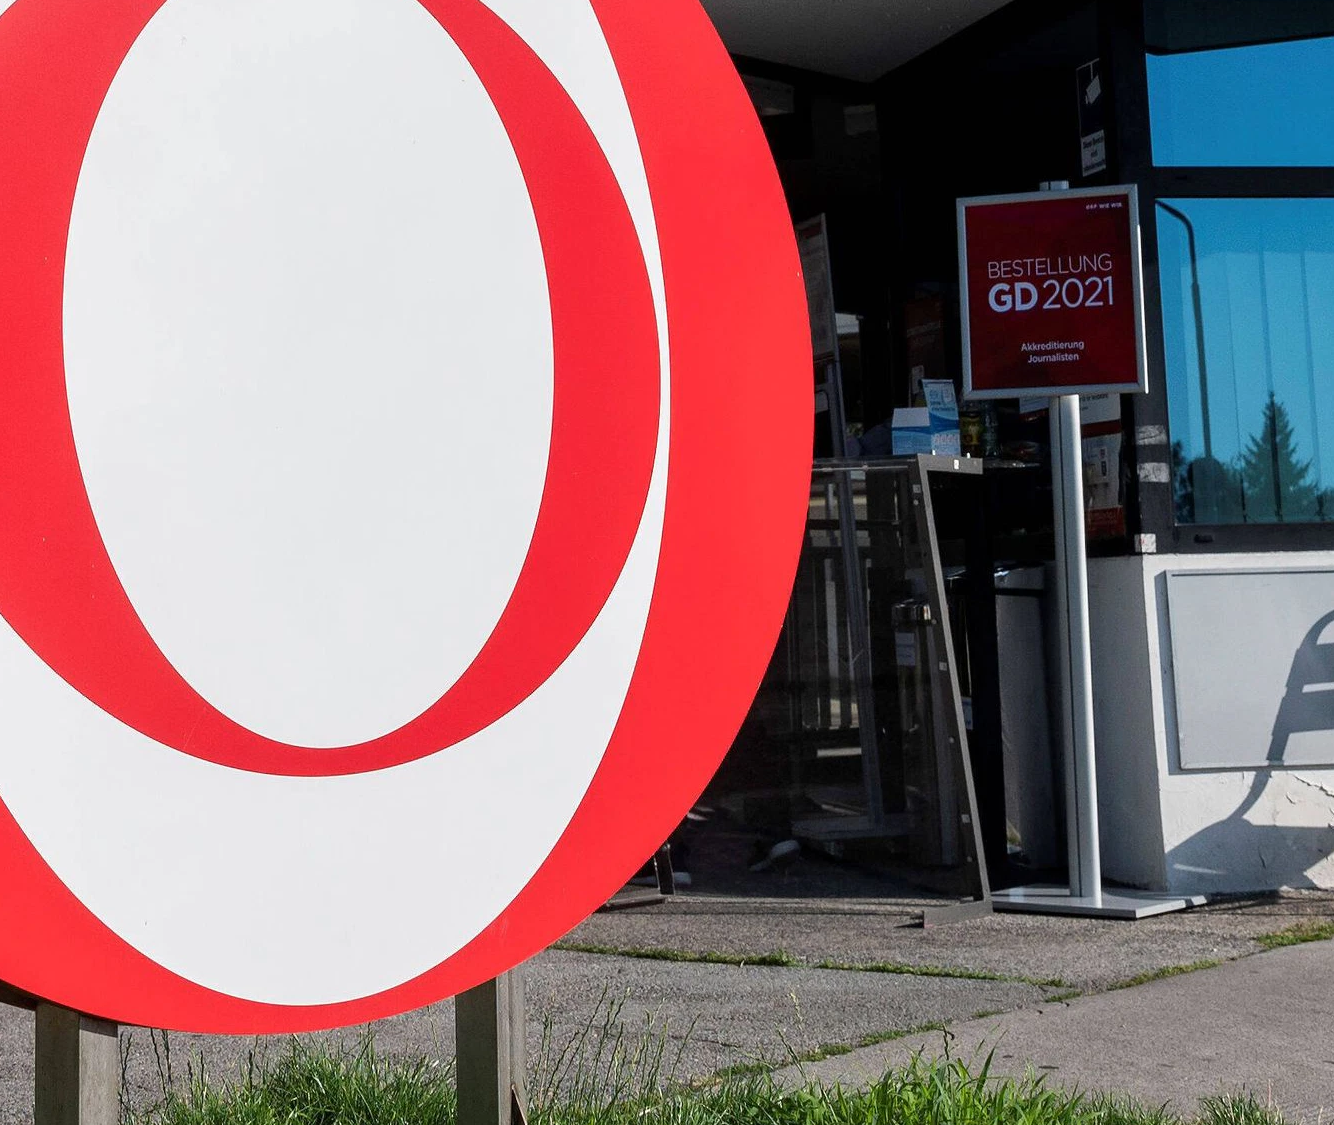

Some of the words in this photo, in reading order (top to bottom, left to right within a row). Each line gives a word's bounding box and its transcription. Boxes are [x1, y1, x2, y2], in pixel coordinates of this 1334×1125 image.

[987, 253, 1113, 279] BESTELLUNG
[1021, 340, 1084, 352] Akkreditierung
[1027, 352, 1079, 364] Journalisten
